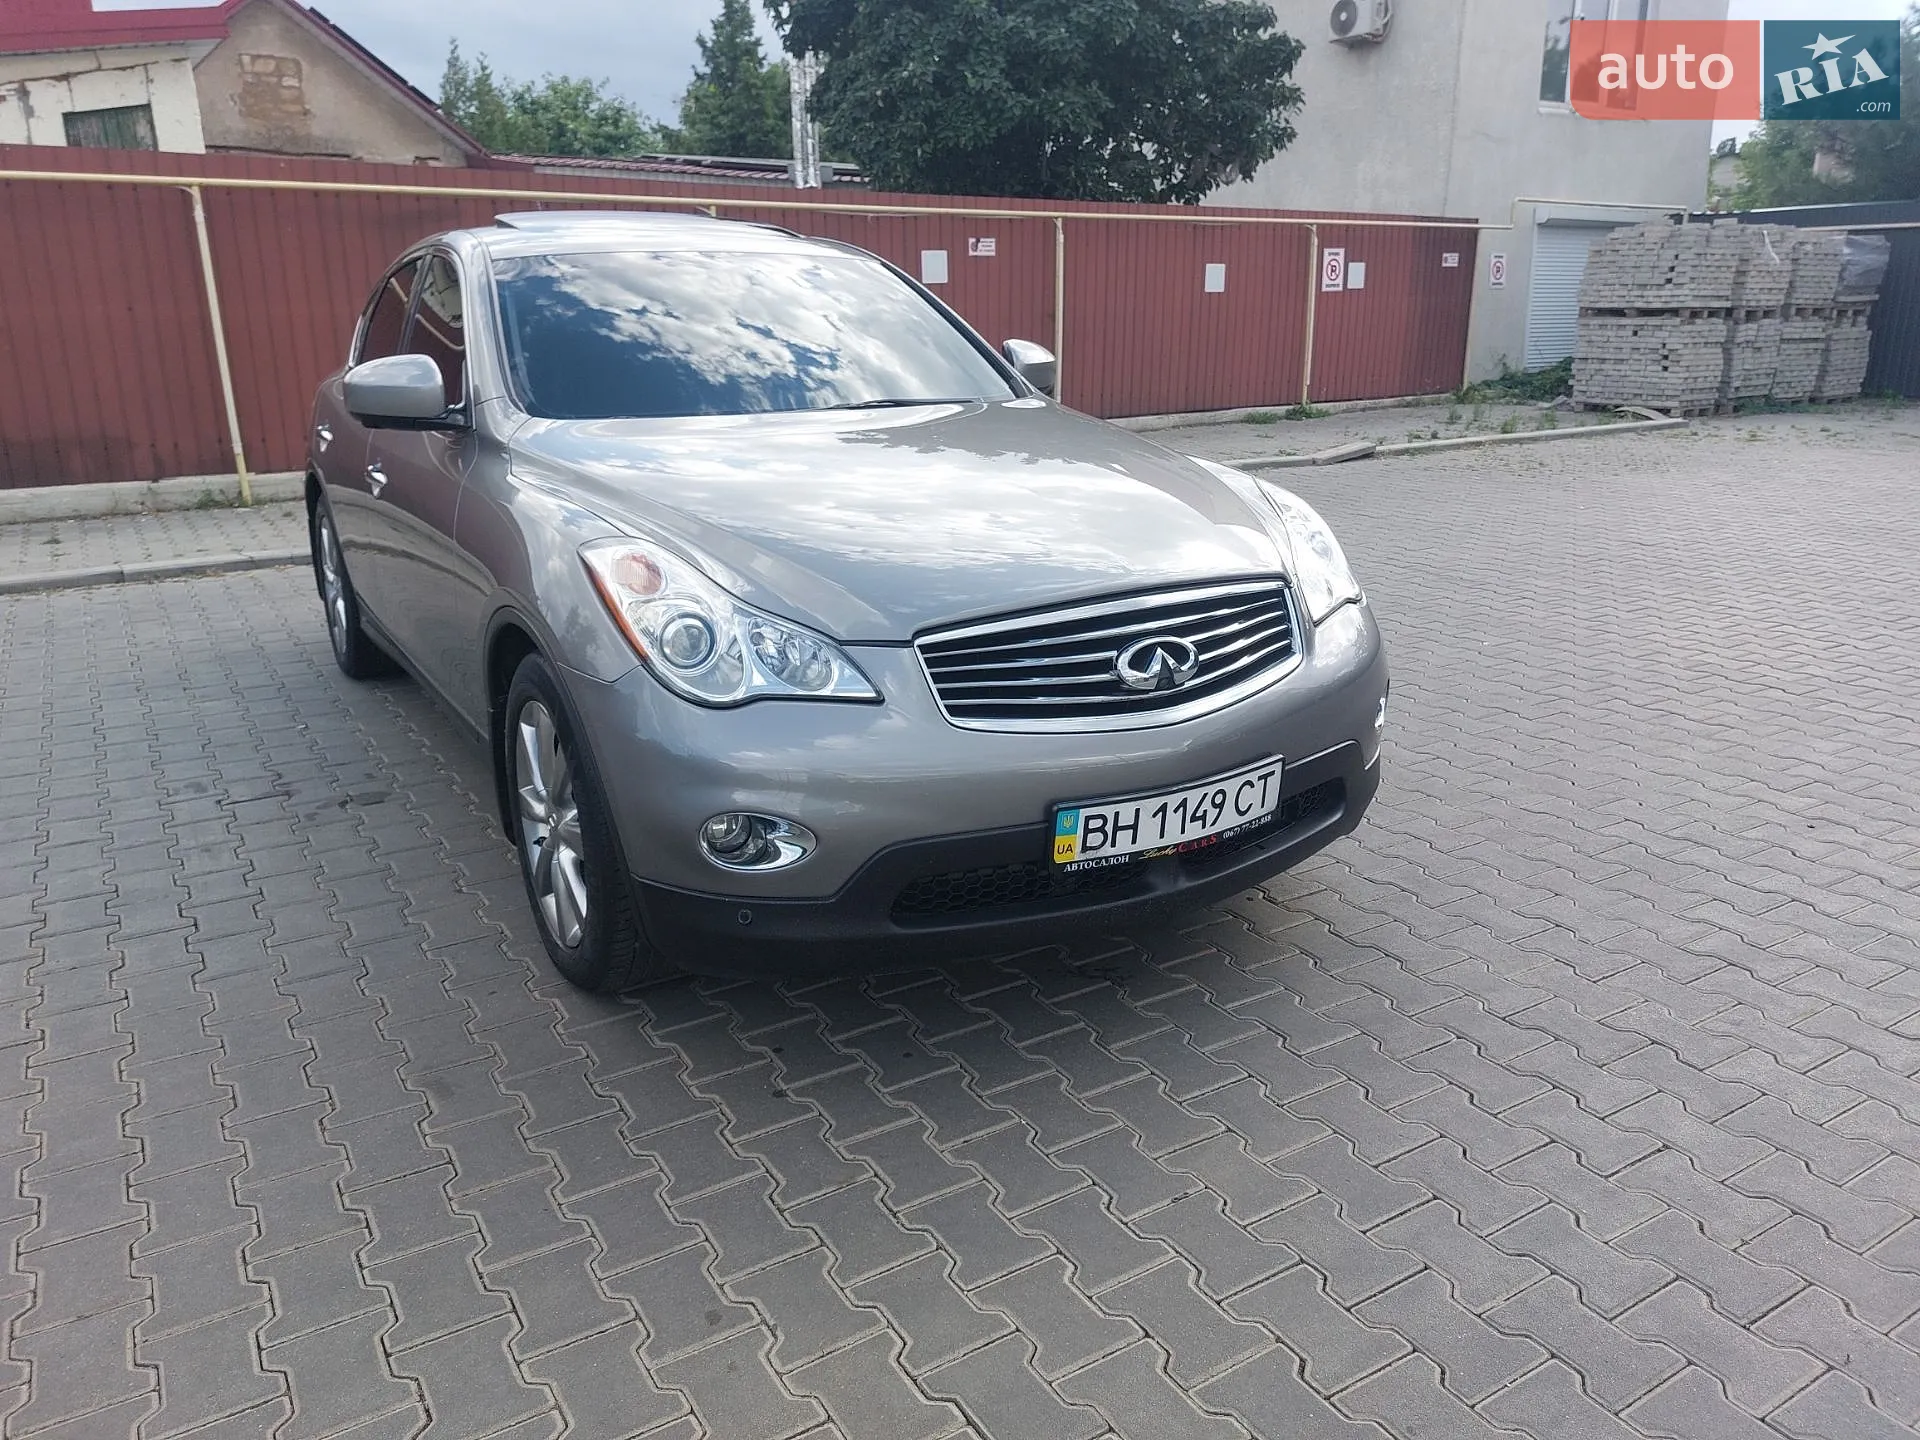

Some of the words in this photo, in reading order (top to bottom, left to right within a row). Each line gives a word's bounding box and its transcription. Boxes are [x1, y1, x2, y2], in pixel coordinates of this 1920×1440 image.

[1081, 808, 1141, 852] BH
[1152, 789, 1227, 839] 1149
[1234, 770, 1276, 816] CT
[1057, 843, 1073, 855] UA
[1064, 855, 1130, 872] АВТОСАЛОН
[1177, 834, 1217, 852] CARS
